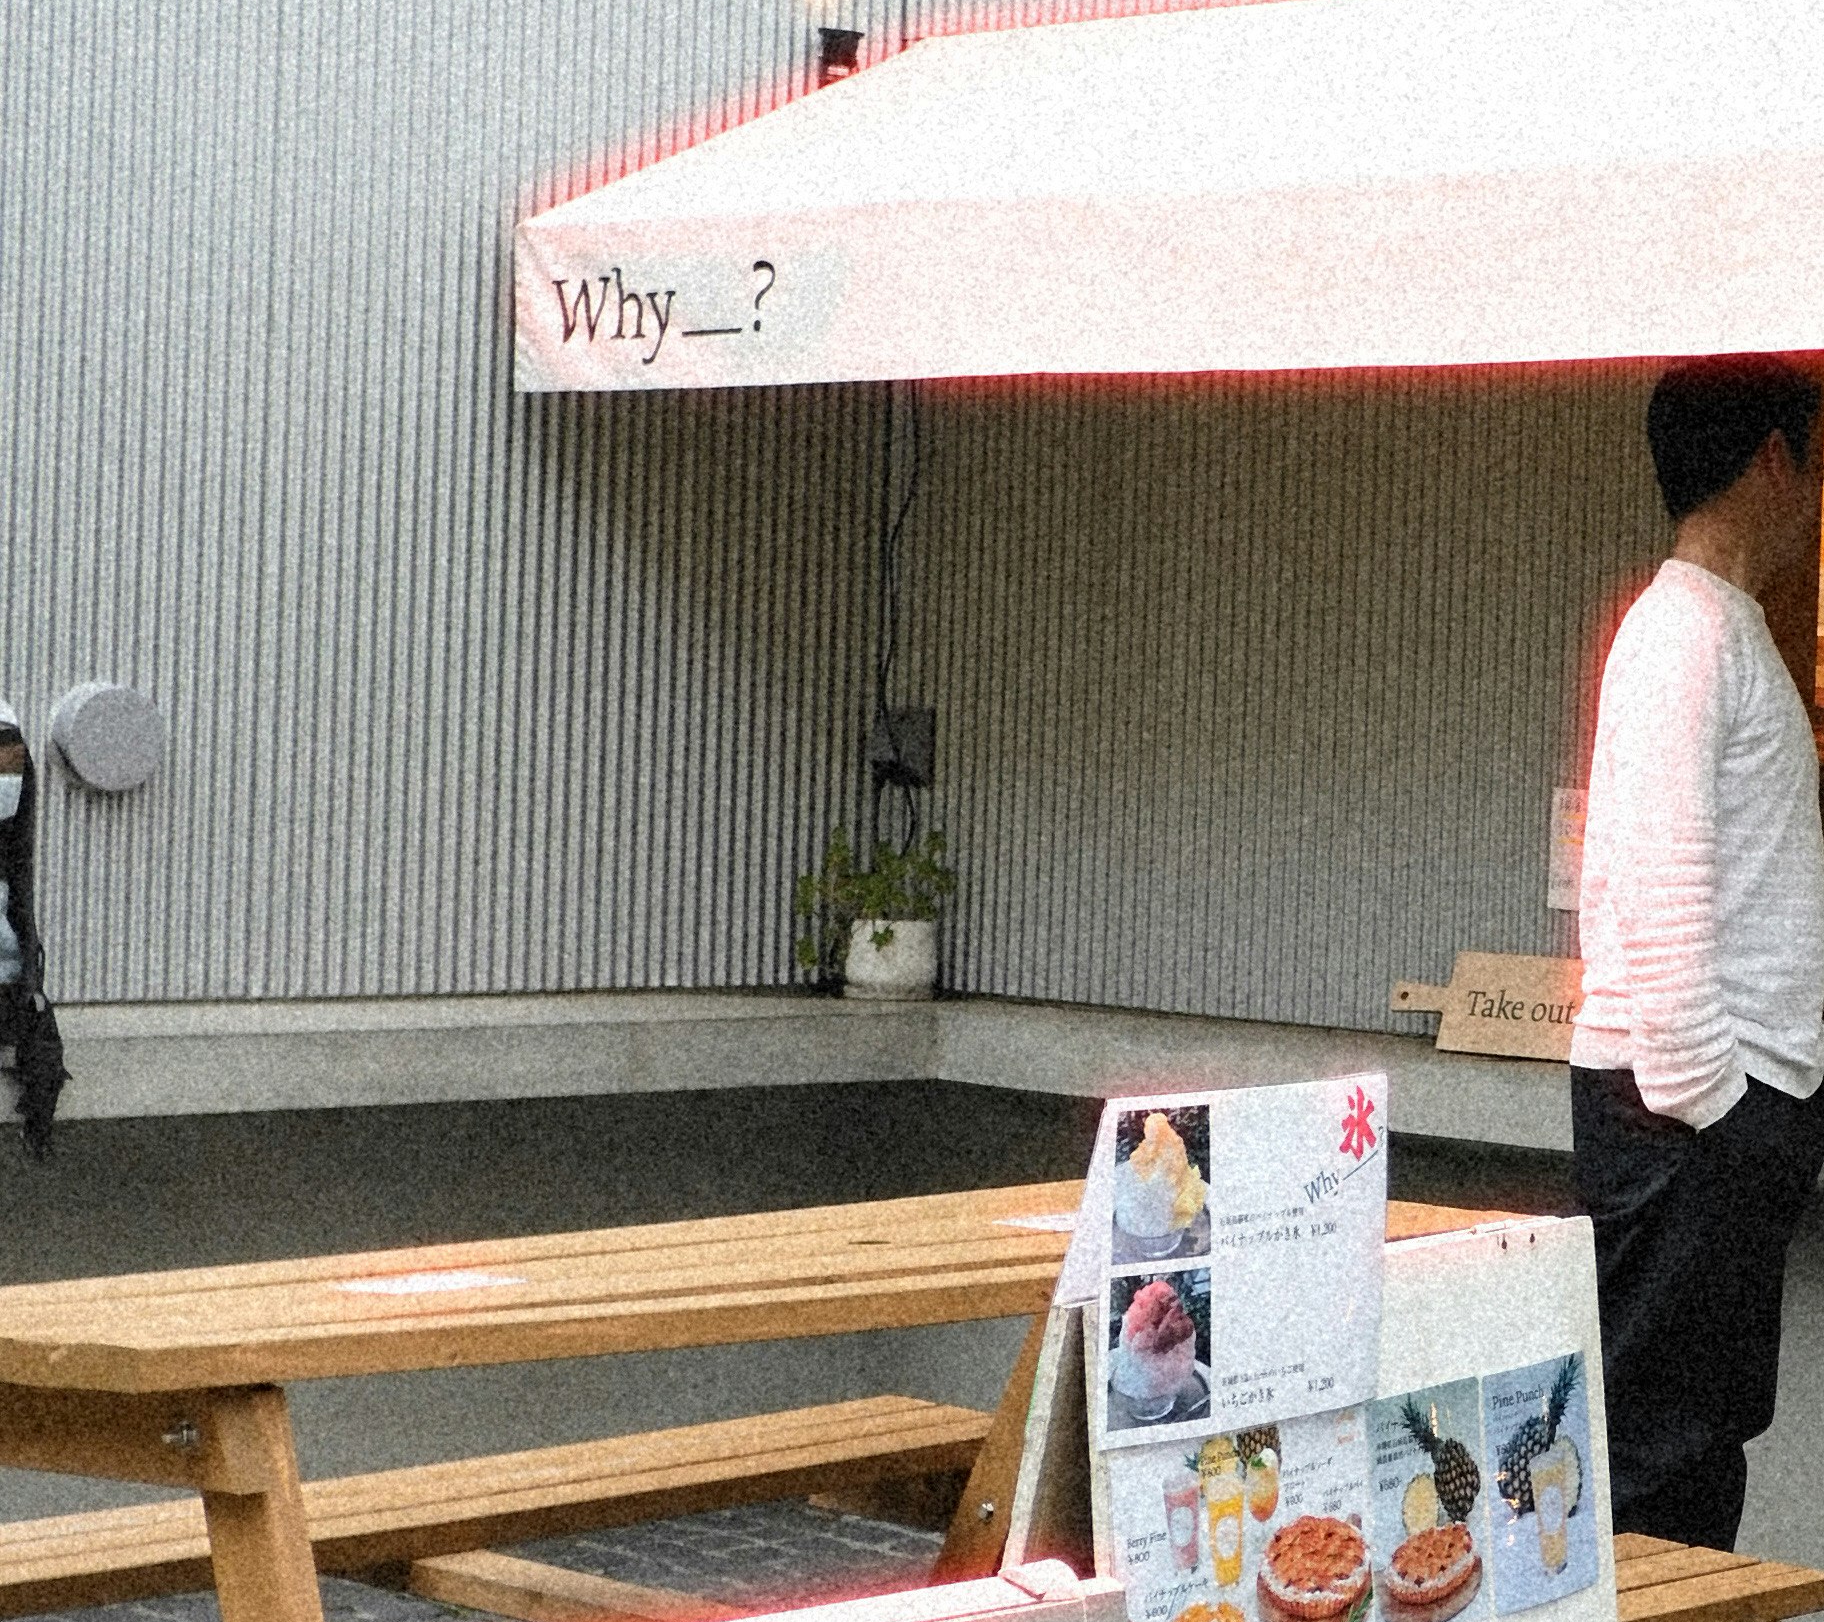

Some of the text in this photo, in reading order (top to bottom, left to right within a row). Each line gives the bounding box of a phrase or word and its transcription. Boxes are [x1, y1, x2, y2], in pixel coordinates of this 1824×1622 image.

[1467, 989, 1577, 1025] Take out
[1338, 1084, 1378, 1163] 氷
